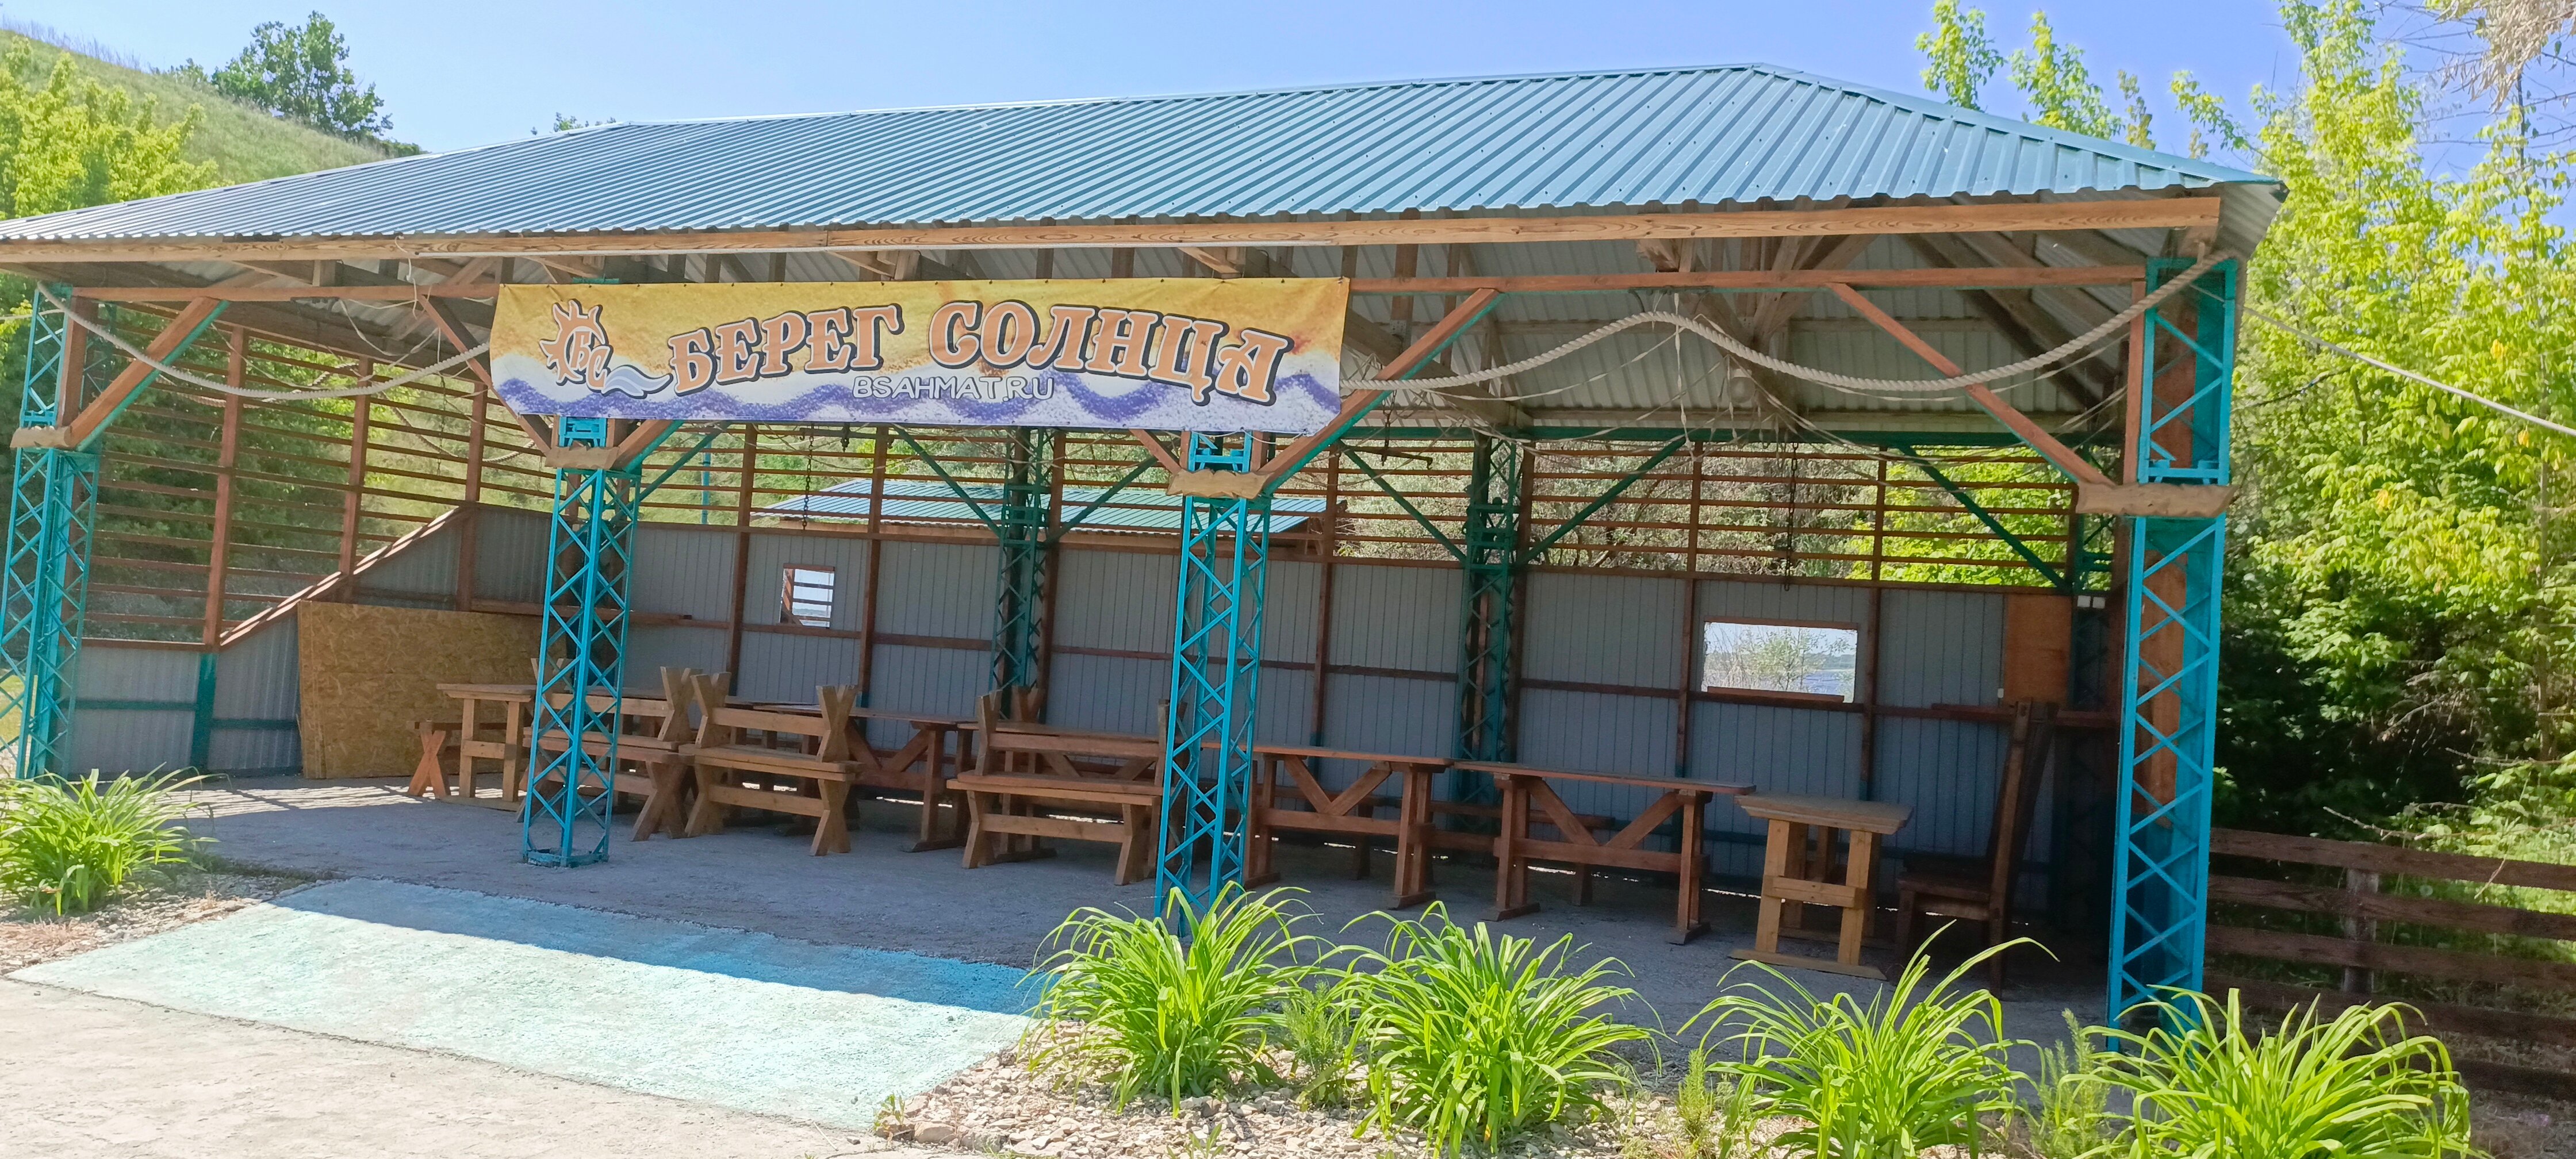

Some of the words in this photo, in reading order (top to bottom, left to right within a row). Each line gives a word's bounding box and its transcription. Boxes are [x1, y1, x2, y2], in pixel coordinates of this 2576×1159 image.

[668, 304, 904, 396] БЕРЕГ
[928, 300, 1294, 406] СОЛНЦА
[853, 376, 1055, 402] BSAHMAT.RU
